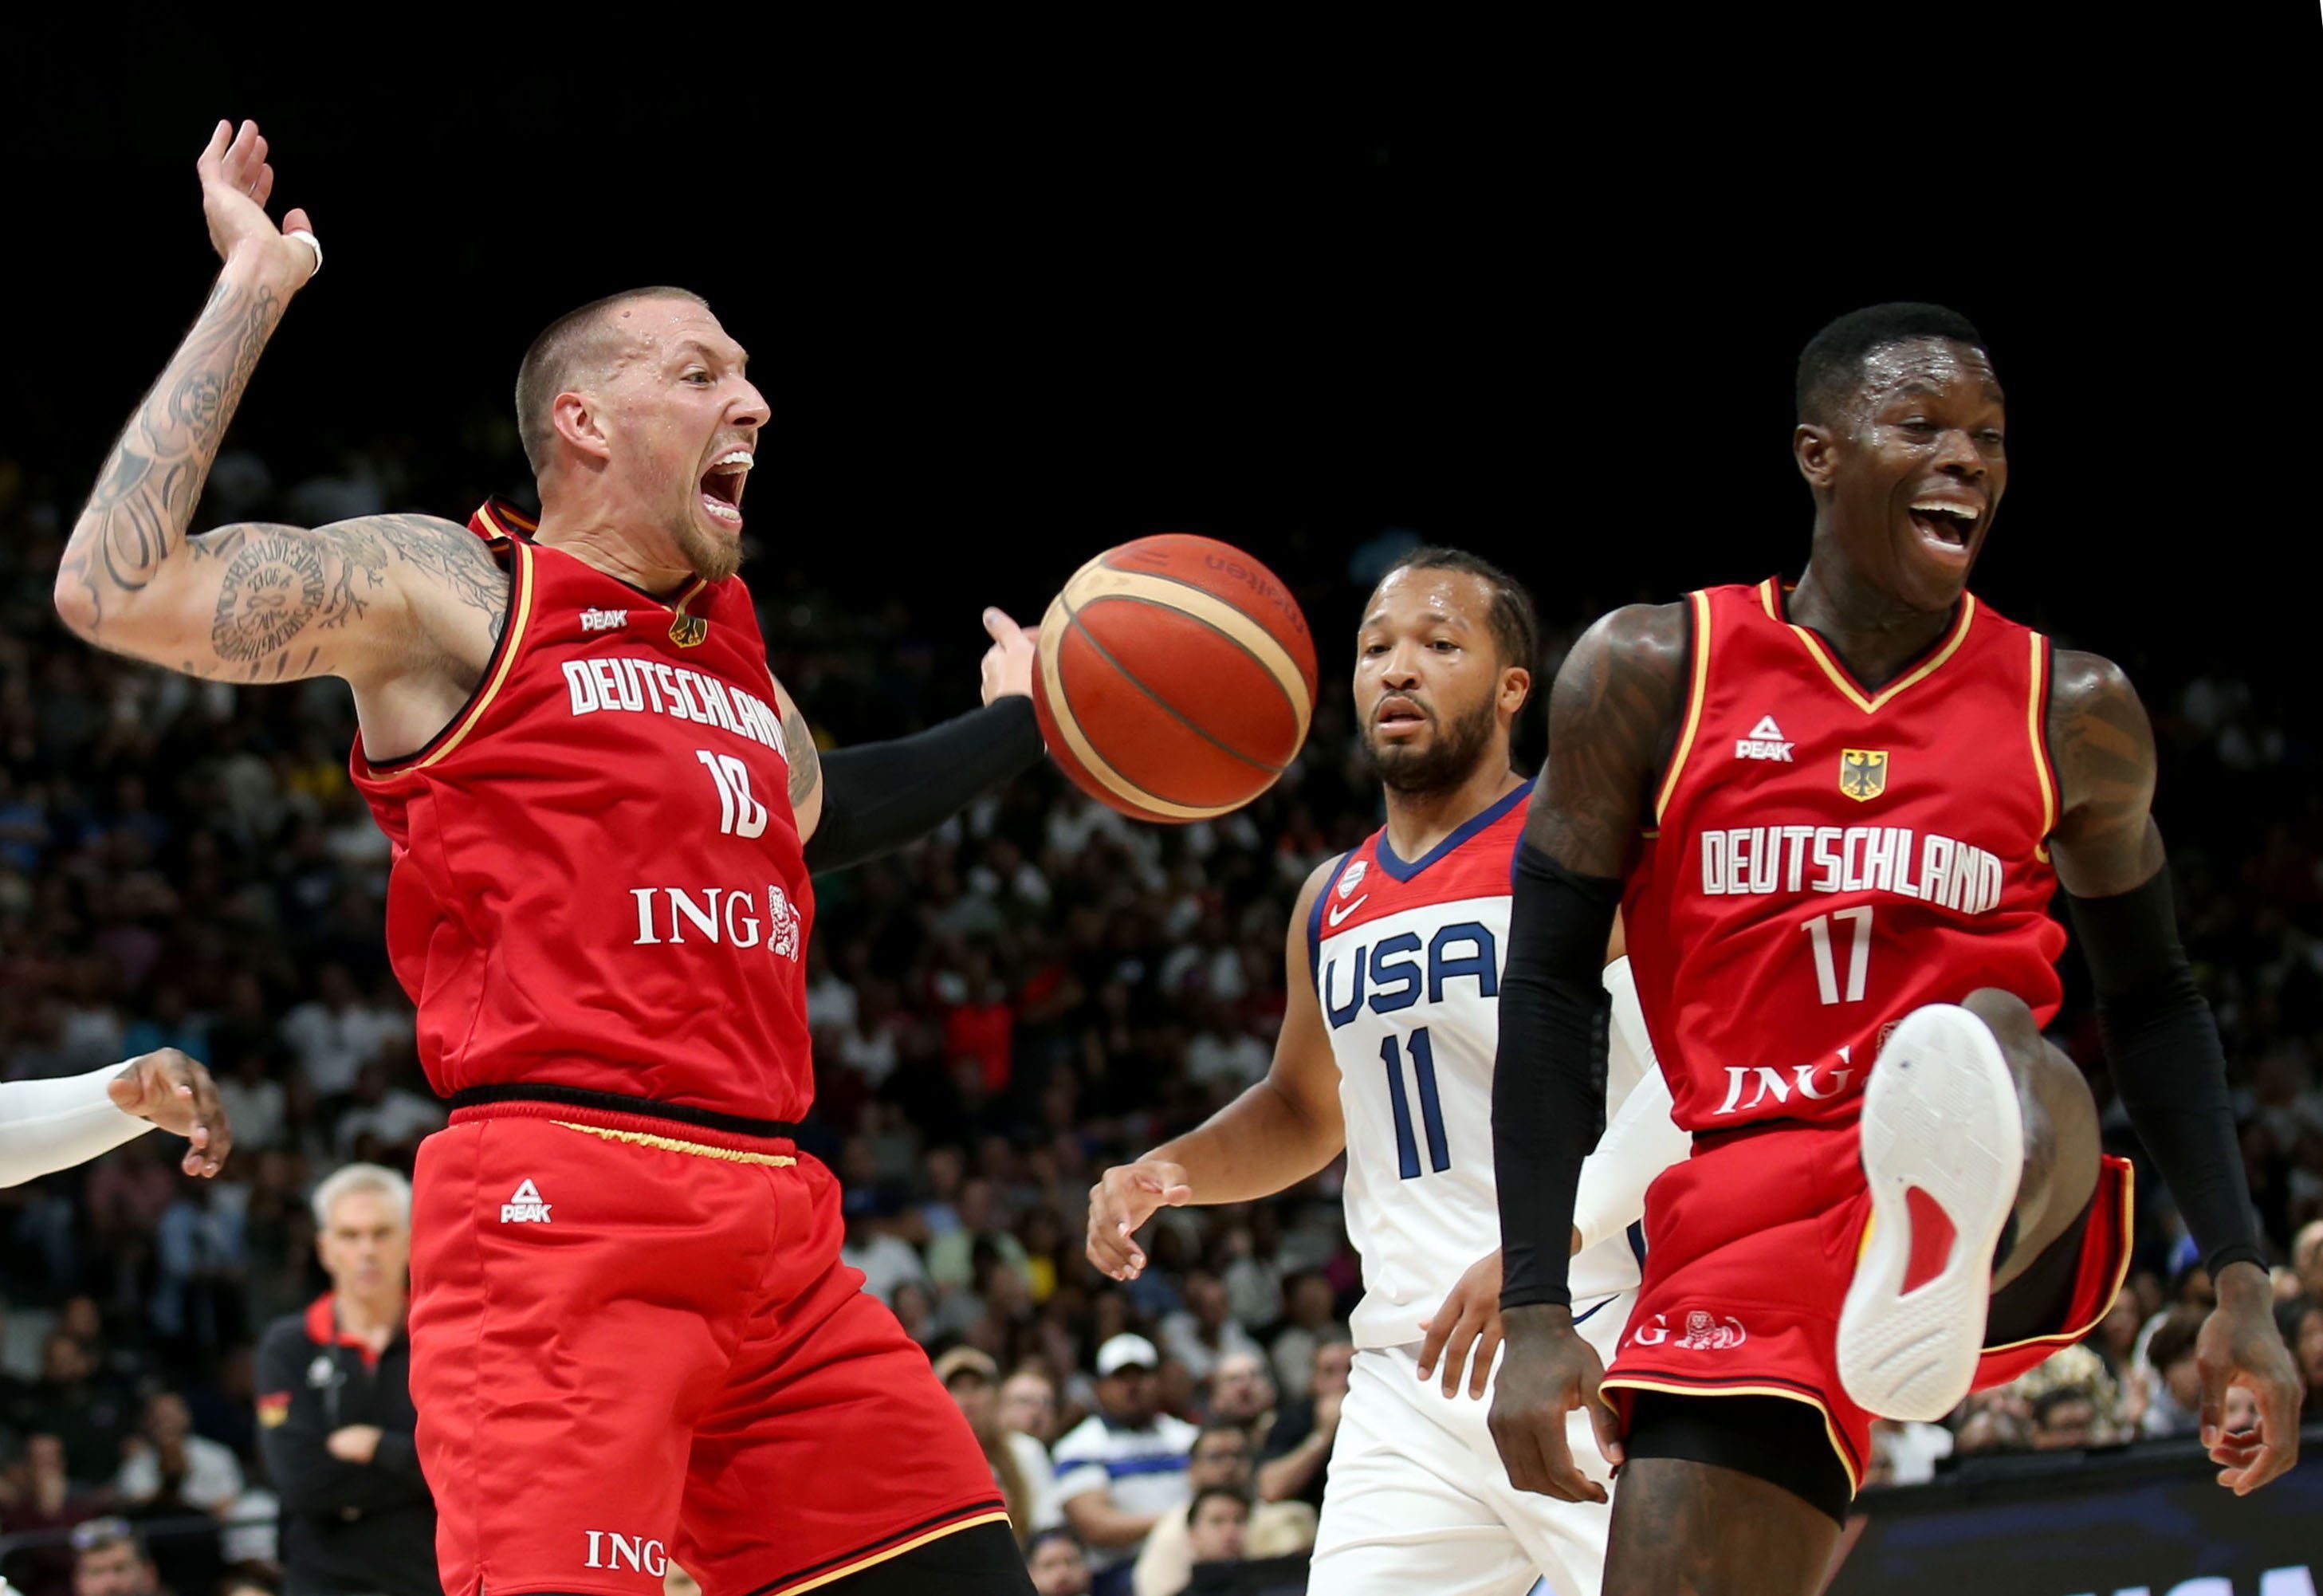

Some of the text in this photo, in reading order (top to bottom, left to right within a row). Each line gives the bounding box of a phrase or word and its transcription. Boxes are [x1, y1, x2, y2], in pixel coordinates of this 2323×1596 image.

[579, 609, 628, 631] PEAK
[561, 658, 788, 765] DEUTSCHLAN
[1735, 738, 1795, 762] PEAK
[1701, 825, 2003, 915] DEUTSCHLAND
[630, 887, 760, 948] ING
[1326, 922, 1499, 1030] USA
[1801, 905, 1873, 1004] 17
[1380, 1027, 1451, 1180] 11
[1712, 1045, 1854, 1115] ING
[501, 1203, 552, 1224] PEAK
[584, 1530, 667, 1578] ING
